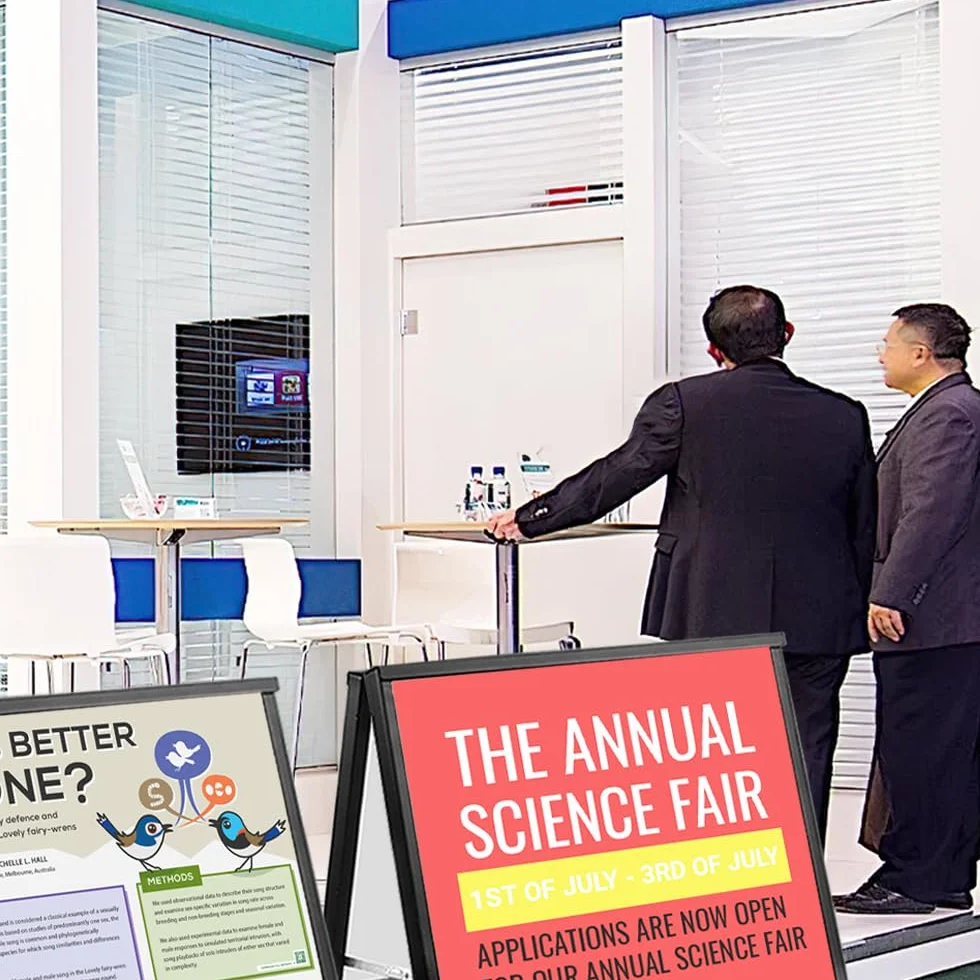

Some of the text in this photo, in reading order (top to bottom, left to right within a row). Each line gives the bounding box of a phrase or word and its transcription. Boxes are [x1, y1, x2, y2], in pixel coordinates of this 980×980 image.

[8, 721, 136, 757] BETTER
[444, 701, 755, 786] THE ANNUAL
[5, 814, 39, 823] defence
[41, 811, 58, 820] and
[26, 824, 76, 835] fairy-wrens
[460, 770, 768, 858] SCIENCE FAIR
[147, 872, 193, 885] METHODS
[470, 845, 776, 909] 1ST OF JULY 3RD OF JULY
[478, 895, 786, 968] APPLICATIONS ARE NOW OPEN
[674, 933, 759, 970] SCIENCE
[763, 926, 807, 955] FAIR
